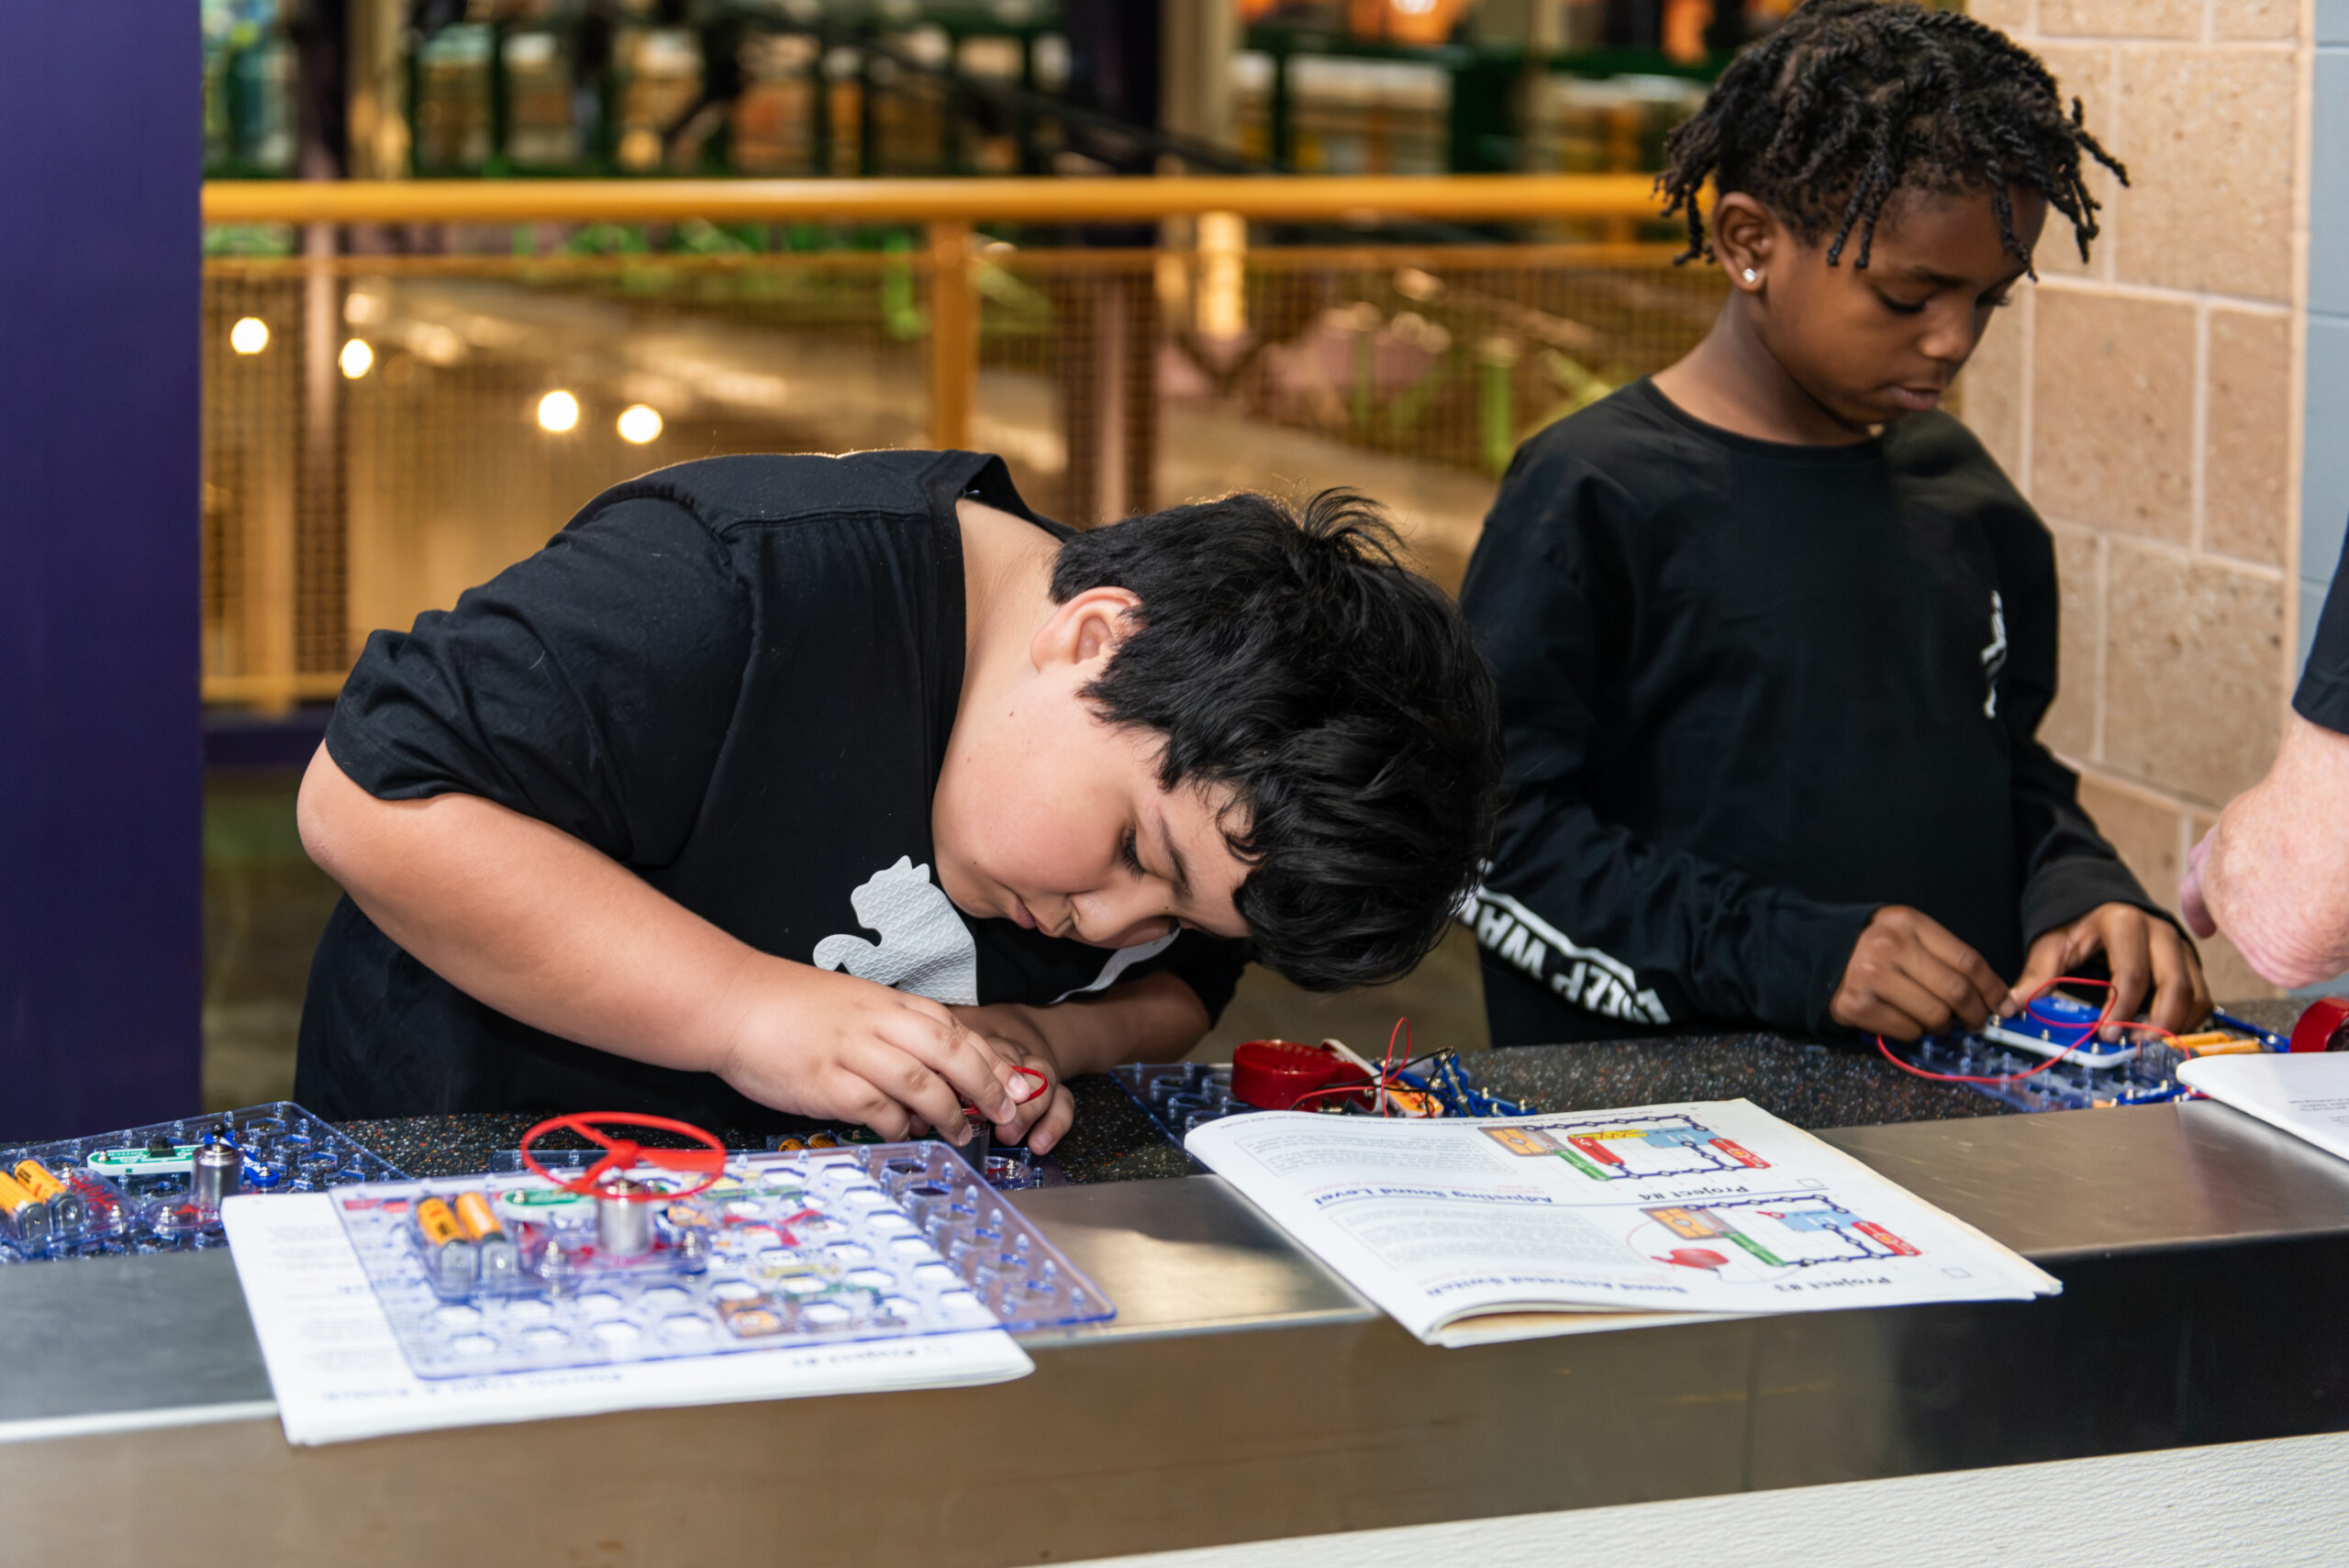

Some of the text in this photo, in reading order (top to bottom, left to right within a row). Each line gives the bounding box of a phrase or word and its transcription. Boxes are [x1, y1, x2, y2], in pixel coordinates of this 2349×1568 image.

[1313, 1187, 1553, 1207] Adjusting Sound Level
[1638, 1184, 1750, 1201] Project #4
[1425, 1276, 1506, 1297] Switch
[1618, 1282, 1689, 1295] Sound
[1808, 1276, 1892, 1290] Project
